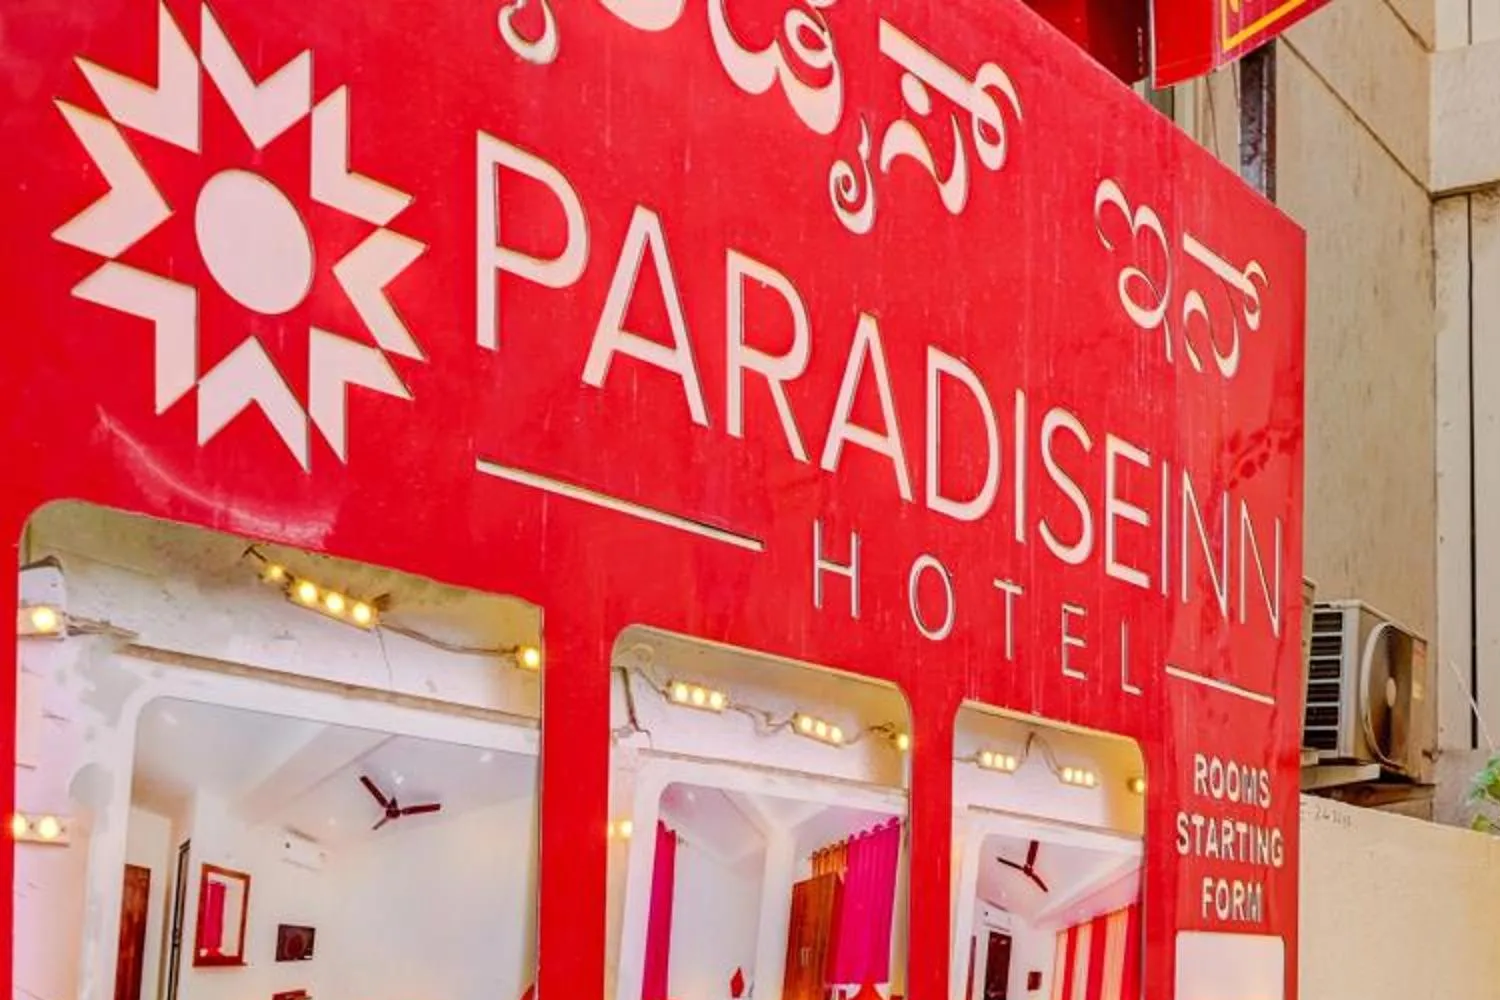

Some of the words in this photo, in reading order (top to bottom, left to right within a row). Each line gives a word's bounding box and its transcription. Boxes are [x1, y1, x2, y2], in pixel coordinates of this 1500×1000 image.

[814, 520, 1142, 696] HOTEL
[1194, 753, 1271, 808] ROOMS
[1177, 812, 1284, 868] STARTING
[1202, 877, 1263, 922] FORM
